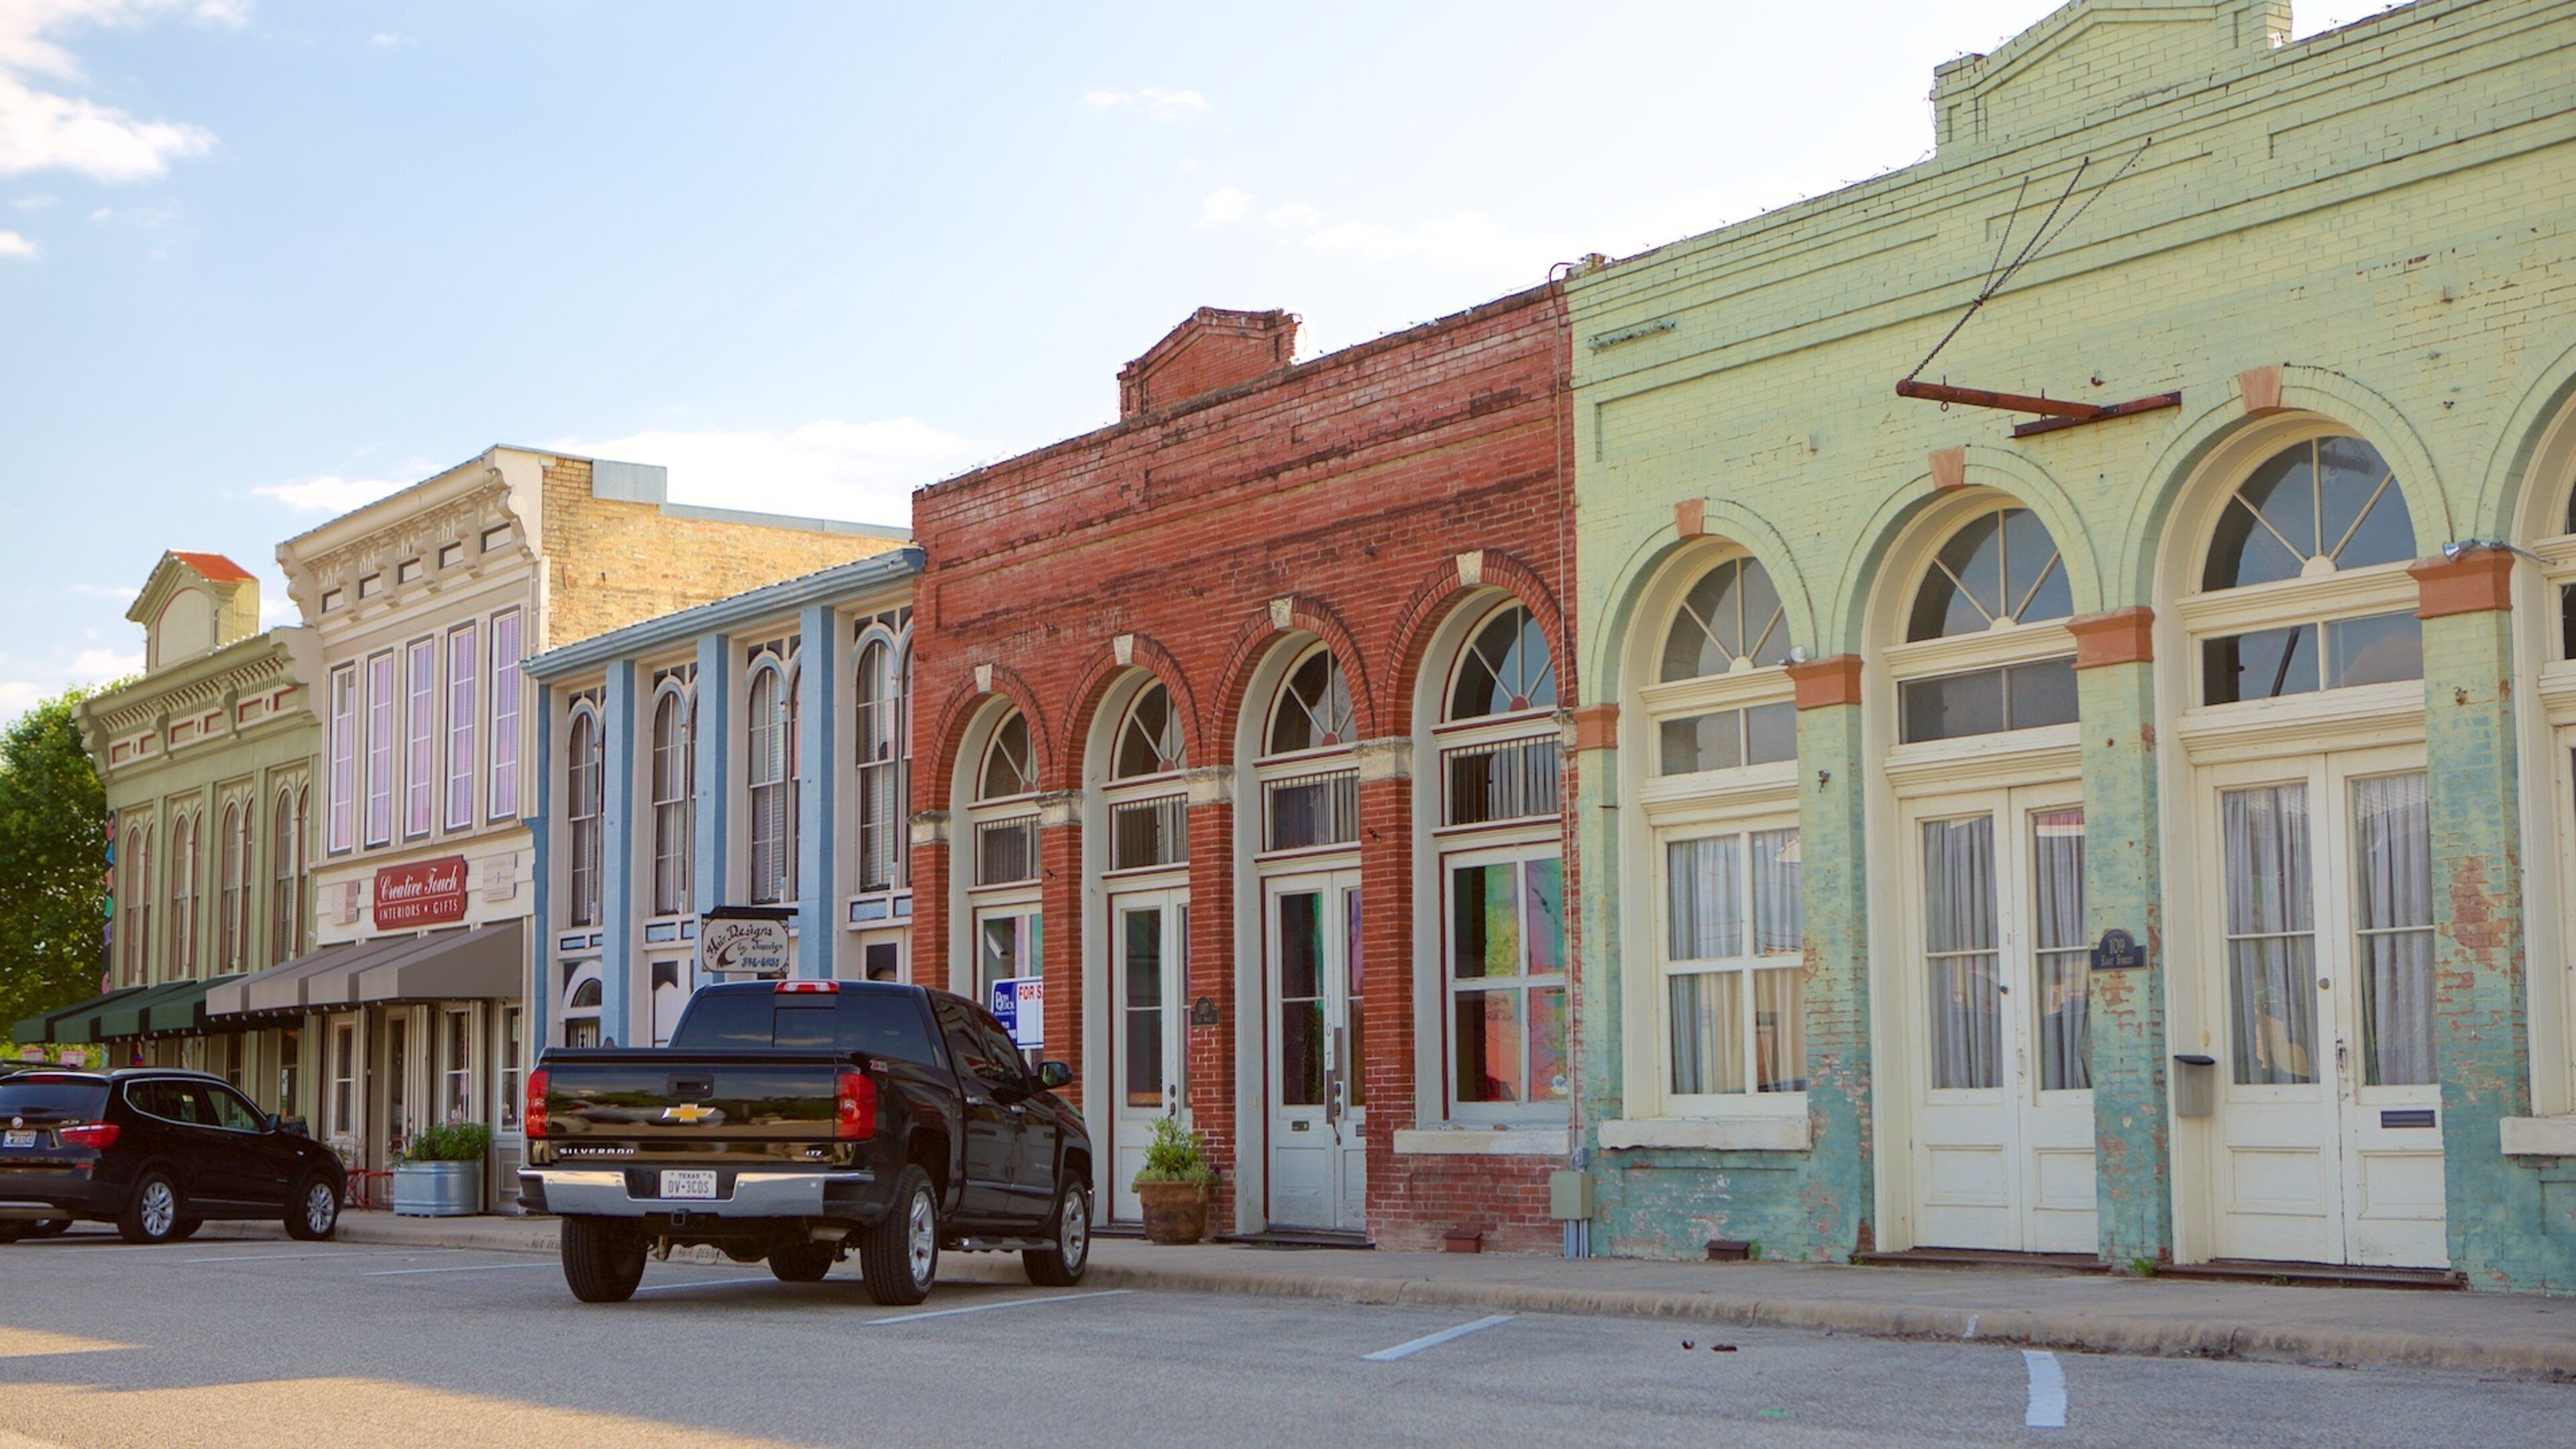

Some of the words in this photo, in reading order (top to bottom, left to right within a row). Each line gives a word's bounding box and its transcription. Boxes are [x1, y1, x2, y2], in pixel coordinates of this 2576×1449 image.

[380, 875, 423, 900] Creative
[424, 865, 457, 894] Touch
[380, 904, 420, 920] INTERIORS
[433, 900, 457, 914] GIFTS
[726, 924, 773, 941] Designs
[2108, 938, 2125, 955] 109
[1018, 986, 1035, 1000] FOR
